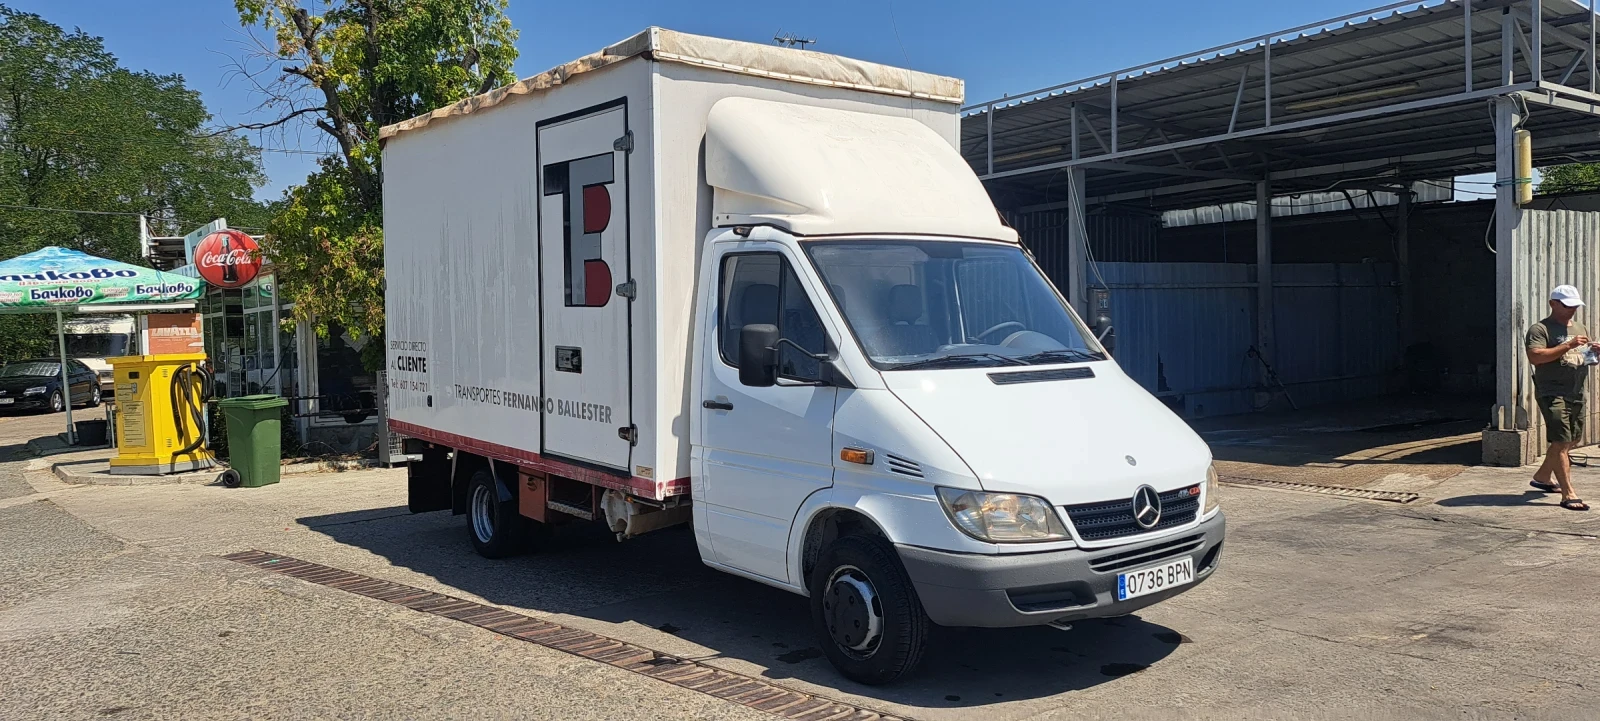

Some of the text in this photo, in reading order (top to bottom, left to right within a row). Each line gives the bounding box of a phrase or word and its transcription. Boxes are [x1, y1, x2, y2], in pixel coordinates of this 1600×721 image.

[30, 286, 93, 300] Бачково
[136, 283, 193, 295] Бачково
[397, 355, 427, 373] CLIENTE
[454, 384, 613, 424] TRANSPORTES FERNANDO BALLESTER
[1128, 560, 1191, 594] 0736 BPN
